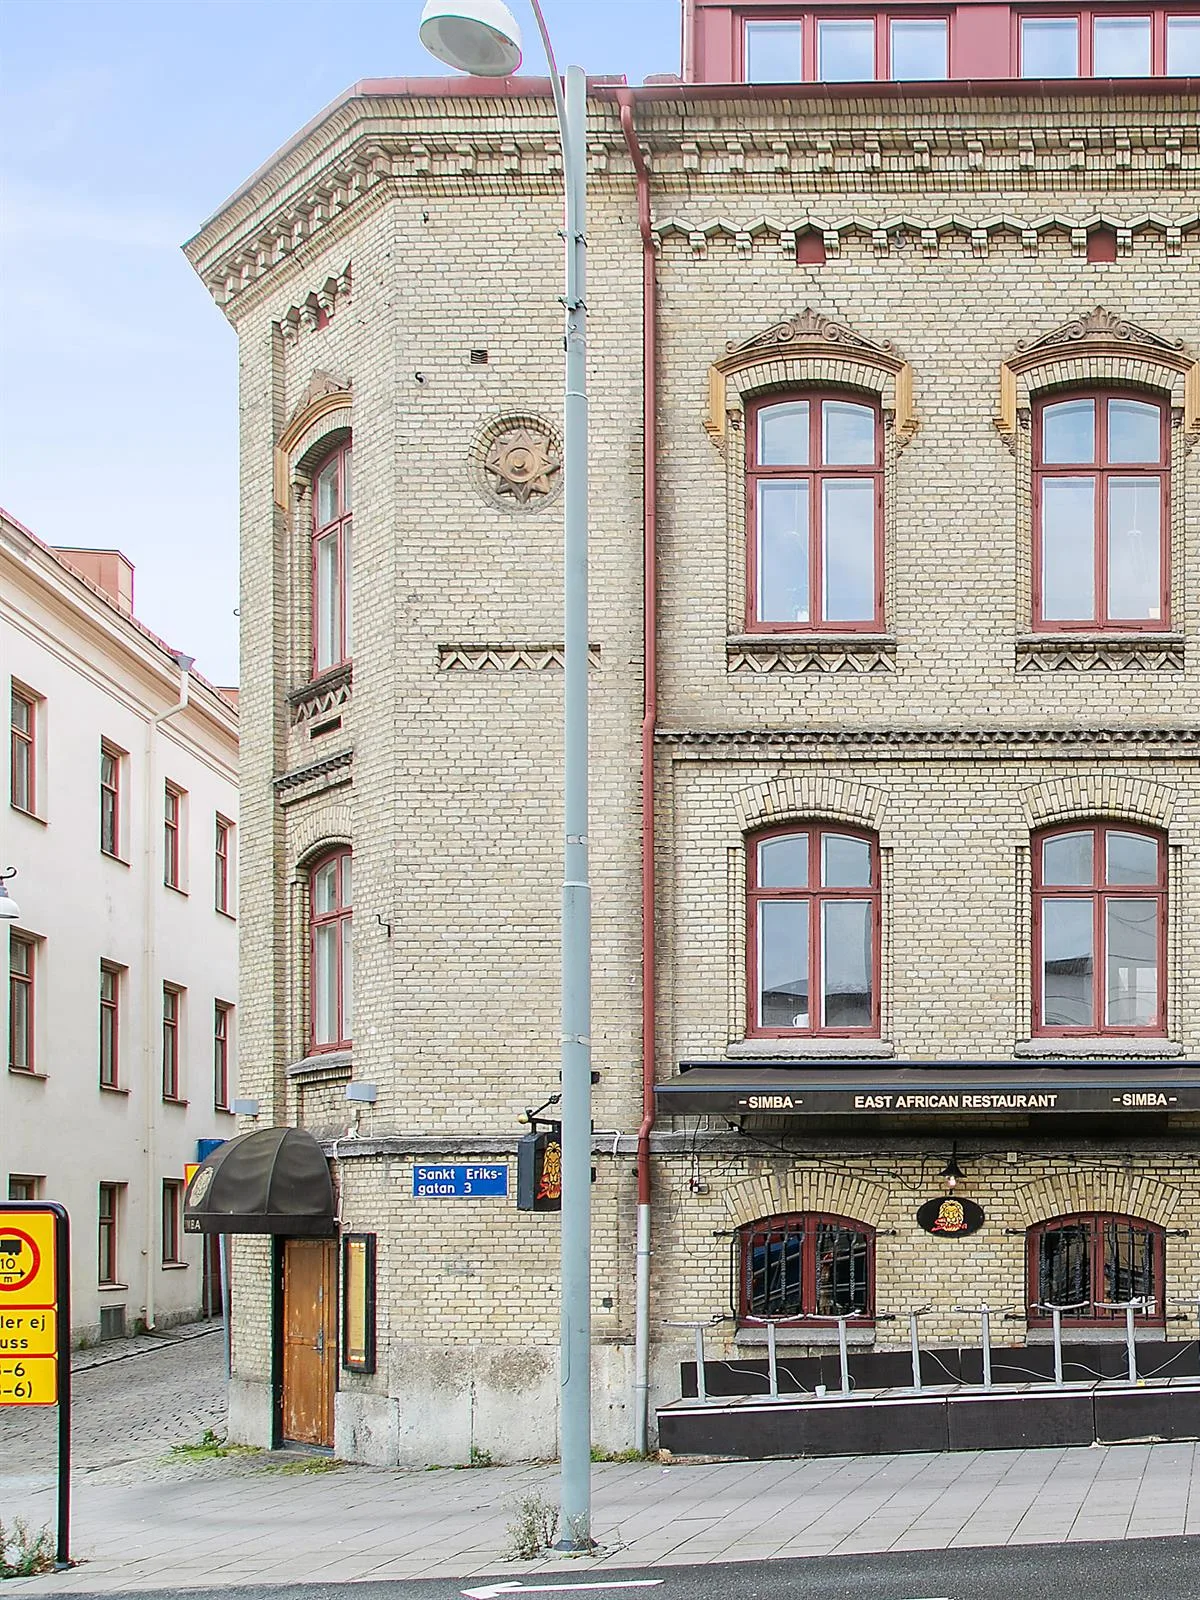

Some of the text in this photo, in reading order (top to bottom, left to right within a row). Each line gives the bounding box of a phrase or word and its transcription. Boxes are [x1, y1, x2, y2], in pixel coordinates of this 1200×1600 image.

[854, 1094, 1057, 1108] EAST AFRICAN RESTAURANT
[418, 1168, 502, 1180] Sankt Eriks-
[418, 1182, 472, 1196] gatan 3
[3, 1275, 13, 1284] m
[30, 1315, 45, 1332] ej
[0, 1362, 25, 1377] -6
[0, 1381, 32, 1399] -6)
